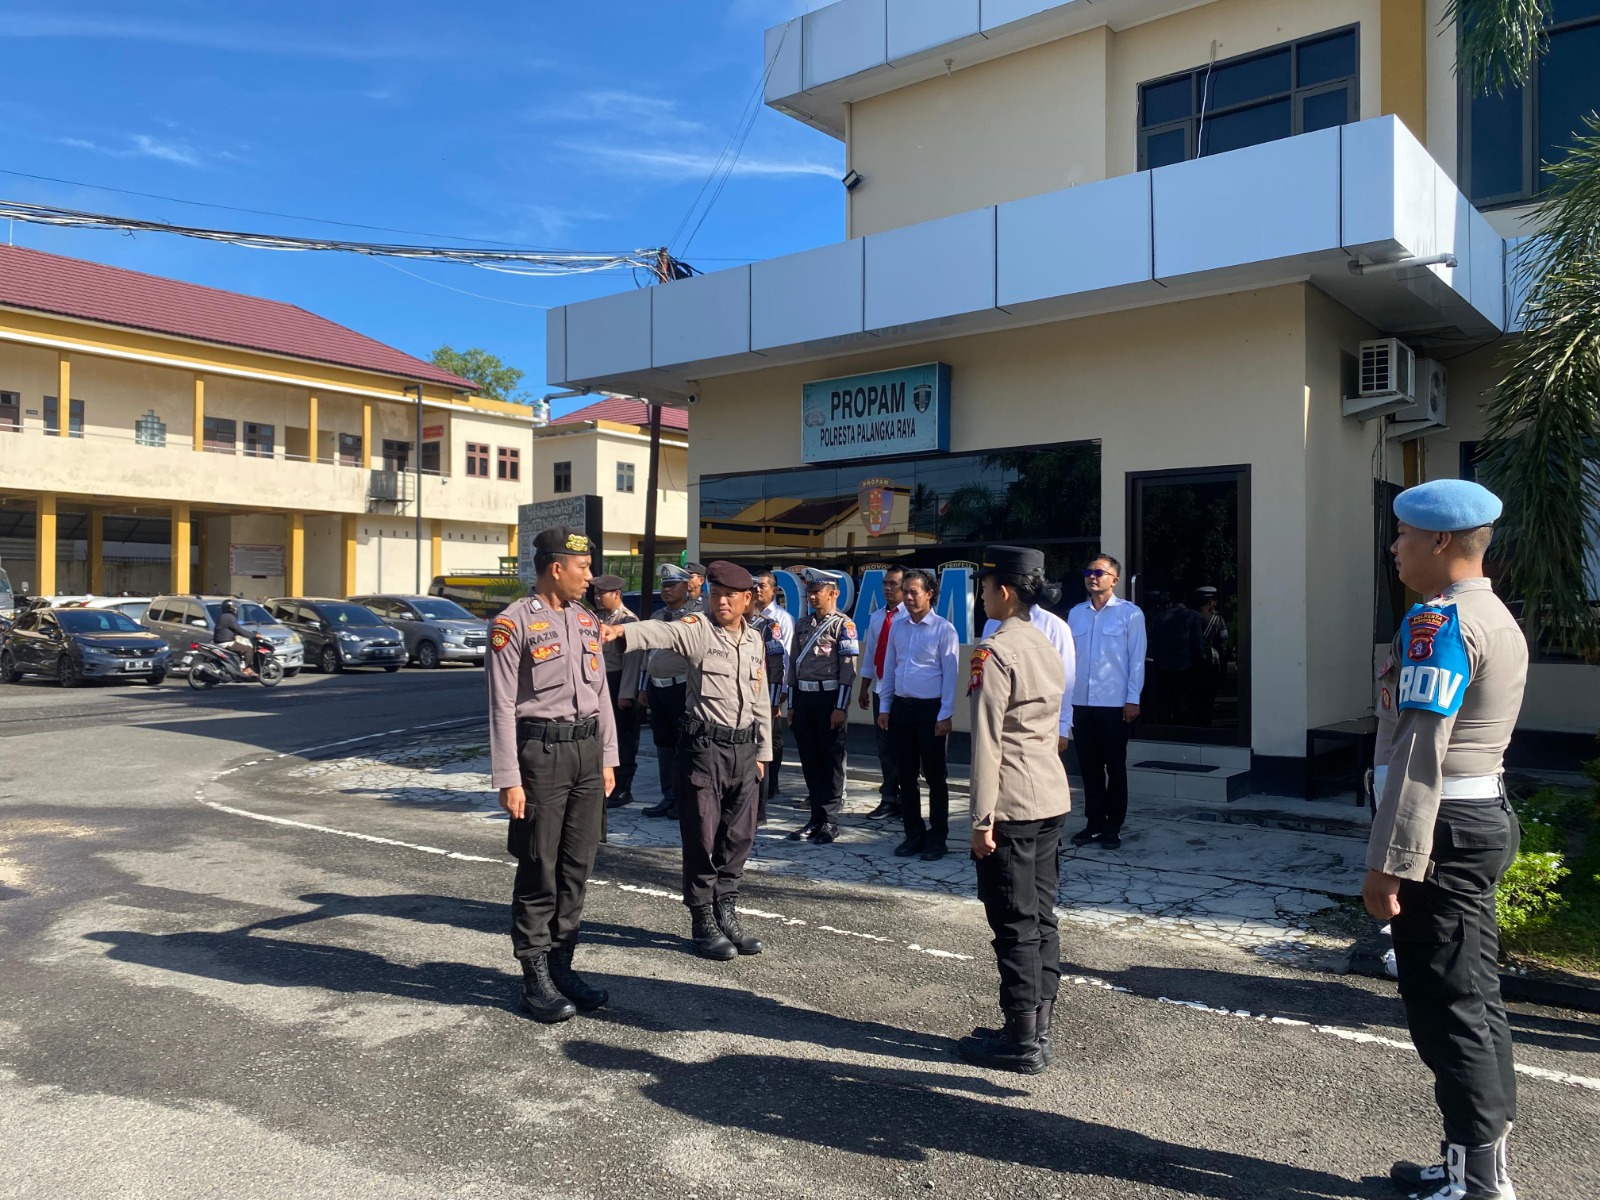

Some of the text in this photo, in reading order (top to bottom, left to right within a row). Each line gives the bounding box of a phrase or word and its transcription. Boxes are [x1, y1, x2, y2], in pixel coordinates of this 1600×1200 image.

[831, 382, 905, 421] PROPAM
[820, 417, 916, 447] POLRESTA PALANGKA RAYA
[862, 479, 889, 487] PROPAM
[860, 564, 888, 572] PROVO
[529, 630, 559, 645] RAZIB
